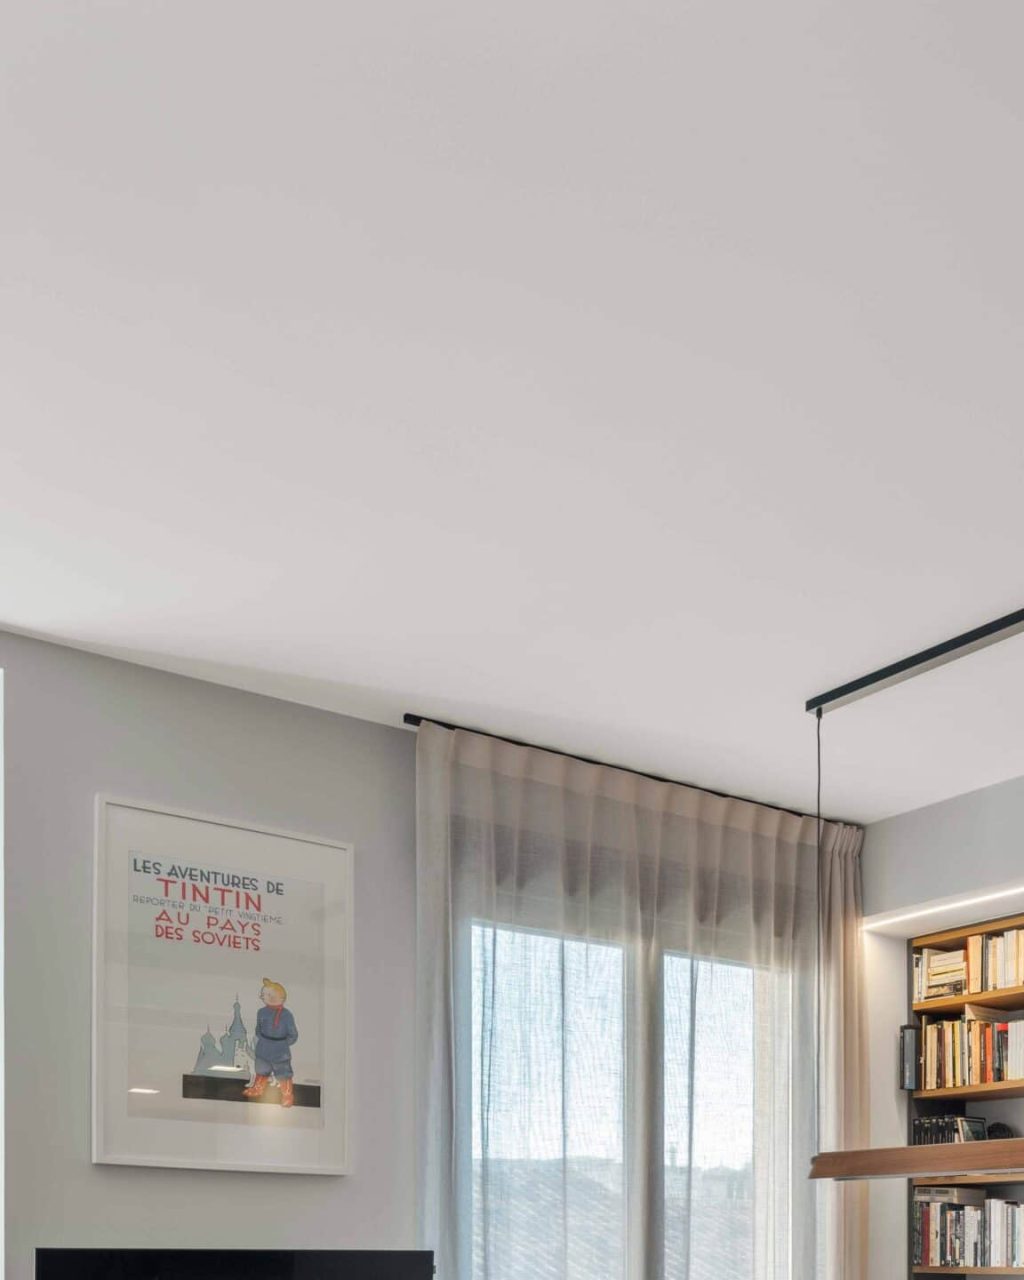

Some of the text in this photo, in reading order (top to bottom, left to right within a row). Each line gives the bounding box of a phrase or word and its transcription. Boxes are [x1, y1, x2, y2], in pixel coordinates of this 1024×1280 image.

[133, 858, 285, 896] LES AVENTURES DE
[156, 877, 262, 913] TINTIN
[155, 909, 262, 937] AU PAYS
[155, 924, 261, 951] DES SOVIETS
